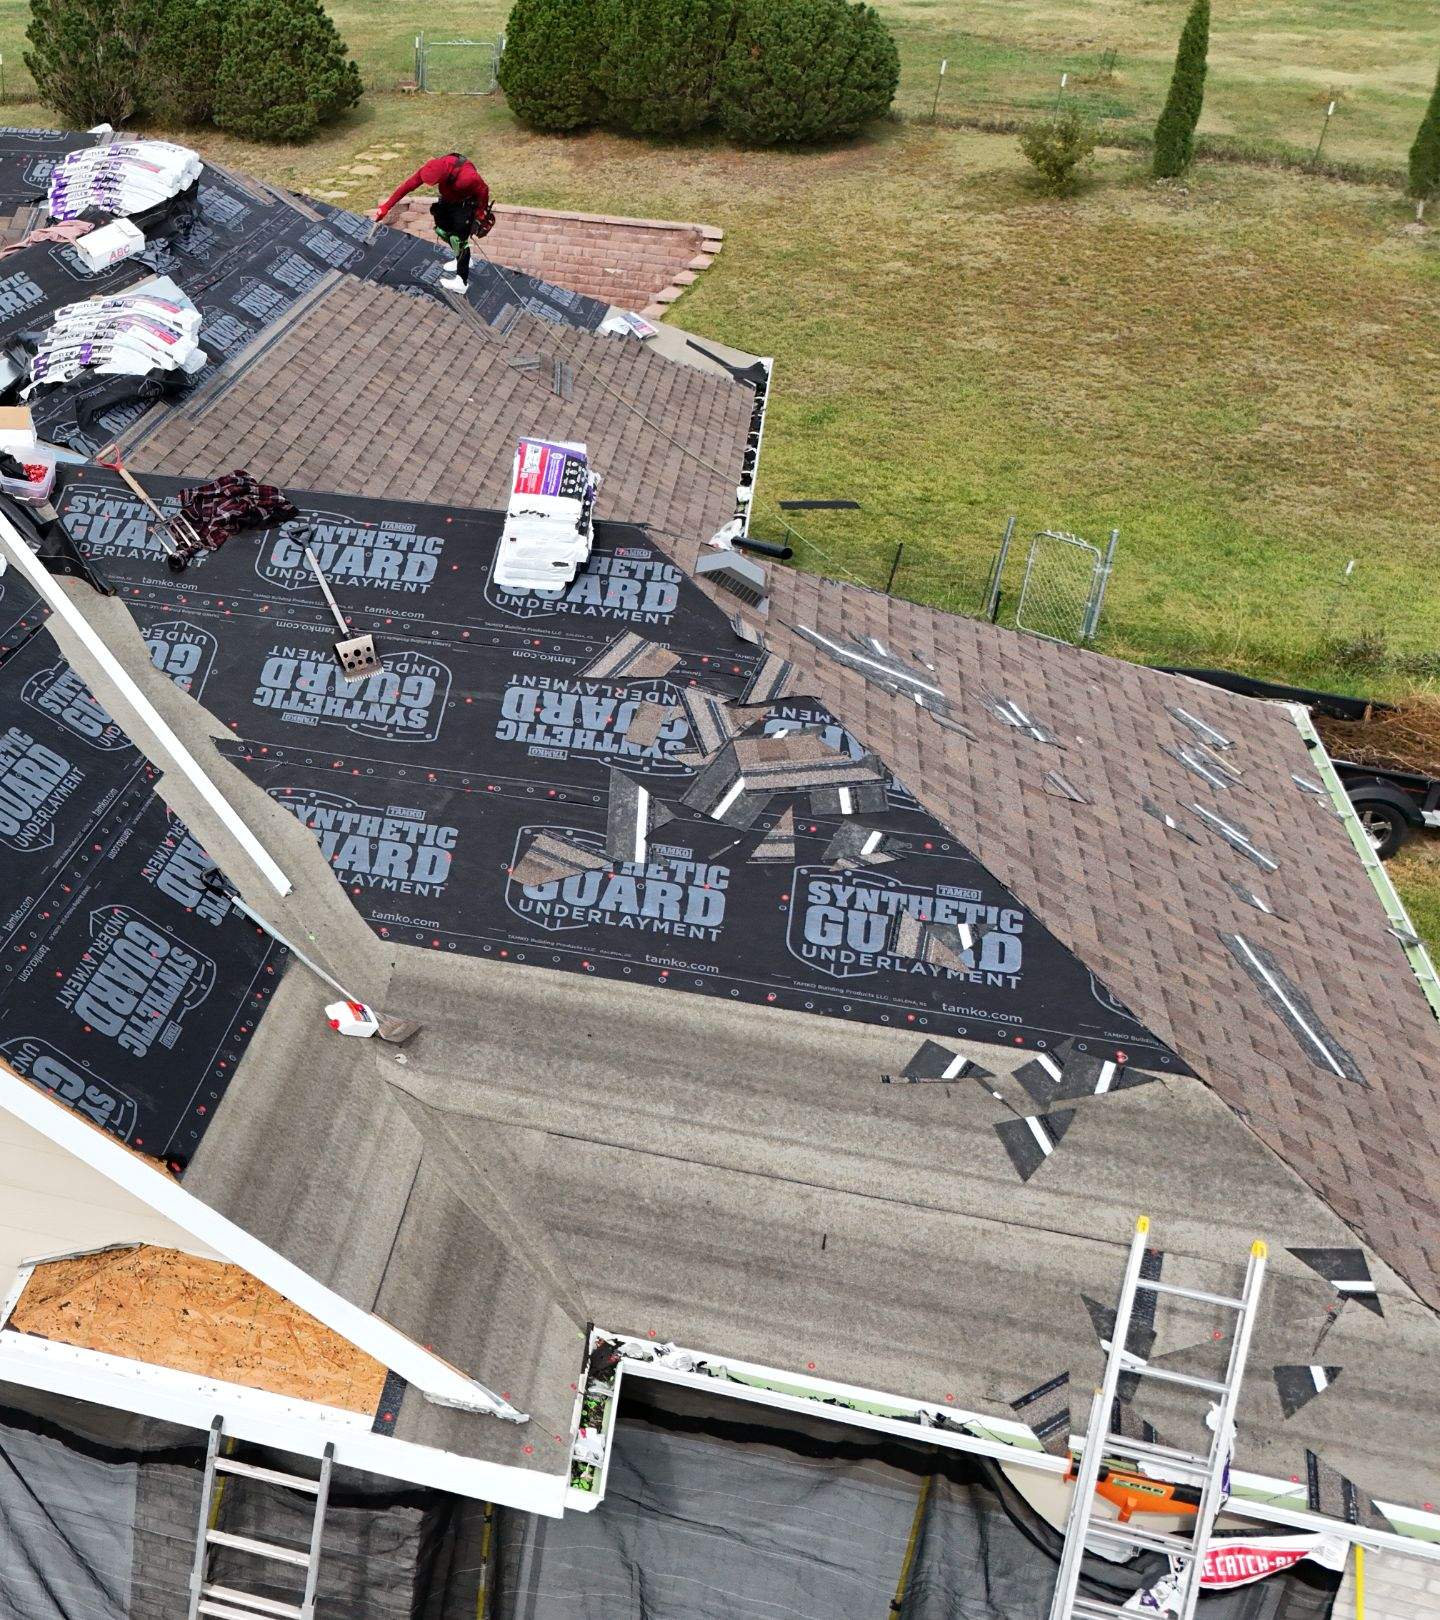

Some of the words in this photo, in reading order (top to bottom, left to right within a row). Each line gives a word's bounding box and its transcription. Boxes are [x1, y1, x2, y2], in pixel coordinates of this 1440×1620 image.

[108, 244, 132, 263] ABC
[280, 520, 445, 555] SYNTHETIC
[381, 521, 416, 532] TAMKO
[270, 538, 438, 583] GUARD
[142, 576, 198, 591] tamko.com
[265, 566, 431, 594] UNDERLAYMENT
[364, 605, 425, 619] tamko.com
[495, 593, 674, 625] UNDERLAYMENT
[276, 621, 335, 634] tamko.com
[512, 650, 576, 665] tamko.com
[260, 657, 436, 708] GUARD
[507, 674, 677, 706] NDERLAYMENT
[252, 686, 429, 729] SYNTHETIC
[282, 712, 319, 726] TAMKO
[528, 746, 568, 760] TAMKO
[14, 766, 87, 848] UNDERLAYMENT
[92, 787, 118, 817] tamko.com
[386, 806, 427, 820] TAMKO
[107, 827, 134, 860] tamko.com
[652, 844, 693, 859] TAMKO
[335, 870, 446, 898] LAYMENT
[522, 871, 726, 927] GUARD
[937, 885, 982, 901] TAMKO
[2, 895, 35, 933] tamko.com
[371, 909, 440, 929] tamko.com
[518, 898, 722, 942] UNDERLAYMENT
[807, 880, 1024, 934] SYNTHETIC
[803, 904, 1022, 974] GUD
[18, 943, 51, 983] tamko.com
[56, 910, 130, 1010] UNDERLAYMENT
[645, 953, 719, 974] tamko.com
[801, 944, 1022, 990] UNDERLAYMENT
[74, 921, 171, 1038] GUARD
[792, 980, 816, 988] TAMKO
[817, 984, 844, 994] Building
[845, 988, 875, 1000] Products
[118, 946, 198, 1058] SYNTHETIC
[941, 1002, 1023, 1025] tamko.com
[1103, 1031, 1129, 1040] TAMKO
